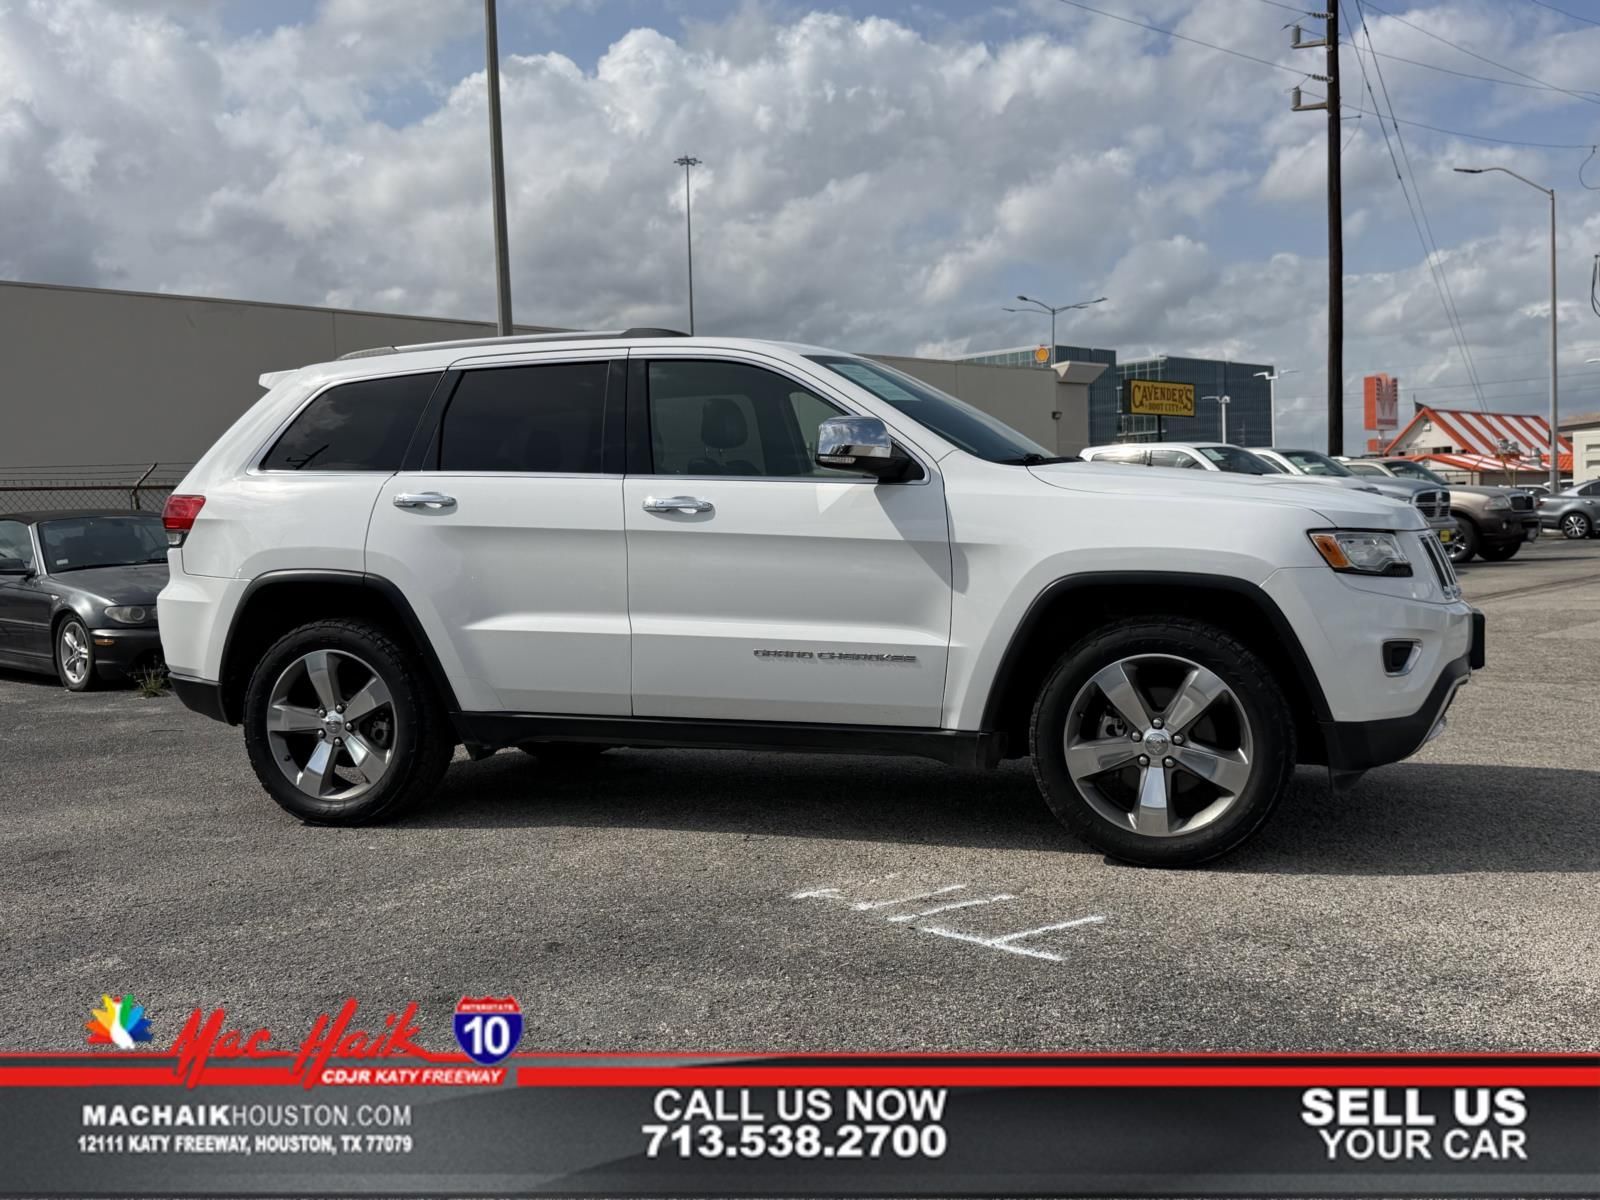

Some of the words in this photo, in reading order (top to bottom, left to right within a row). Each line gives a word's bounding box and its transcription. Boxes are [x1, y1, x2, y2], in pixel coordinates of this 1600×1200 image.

[1132, 384, 1193, 411] CAVENDER'S
[753, 649, 814, 659] GRAND
[817, 652, 917, 662] CHEROKEE
